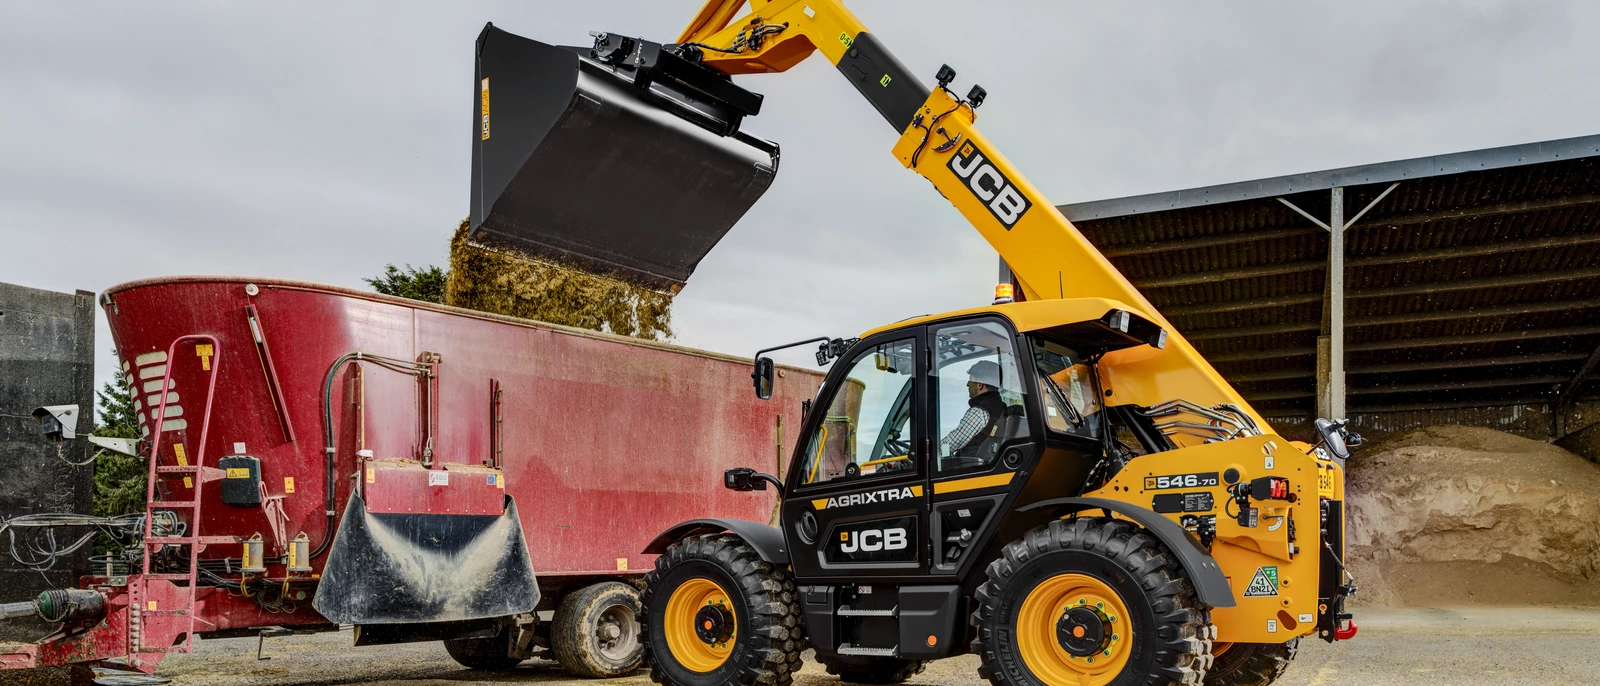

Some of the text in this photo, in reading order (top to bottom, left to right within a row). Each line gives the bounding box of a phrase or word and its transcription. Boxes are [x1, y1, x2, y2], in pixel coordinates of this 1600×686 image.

[951, 153, 1026, 225] JCB
[1157, 474, 1217, 489] 546-70
[826, 486, 914, 509] AGRIXTRA
[840, 527, 908, 553] JCB
[1255, 578, 1265, 586] 41
